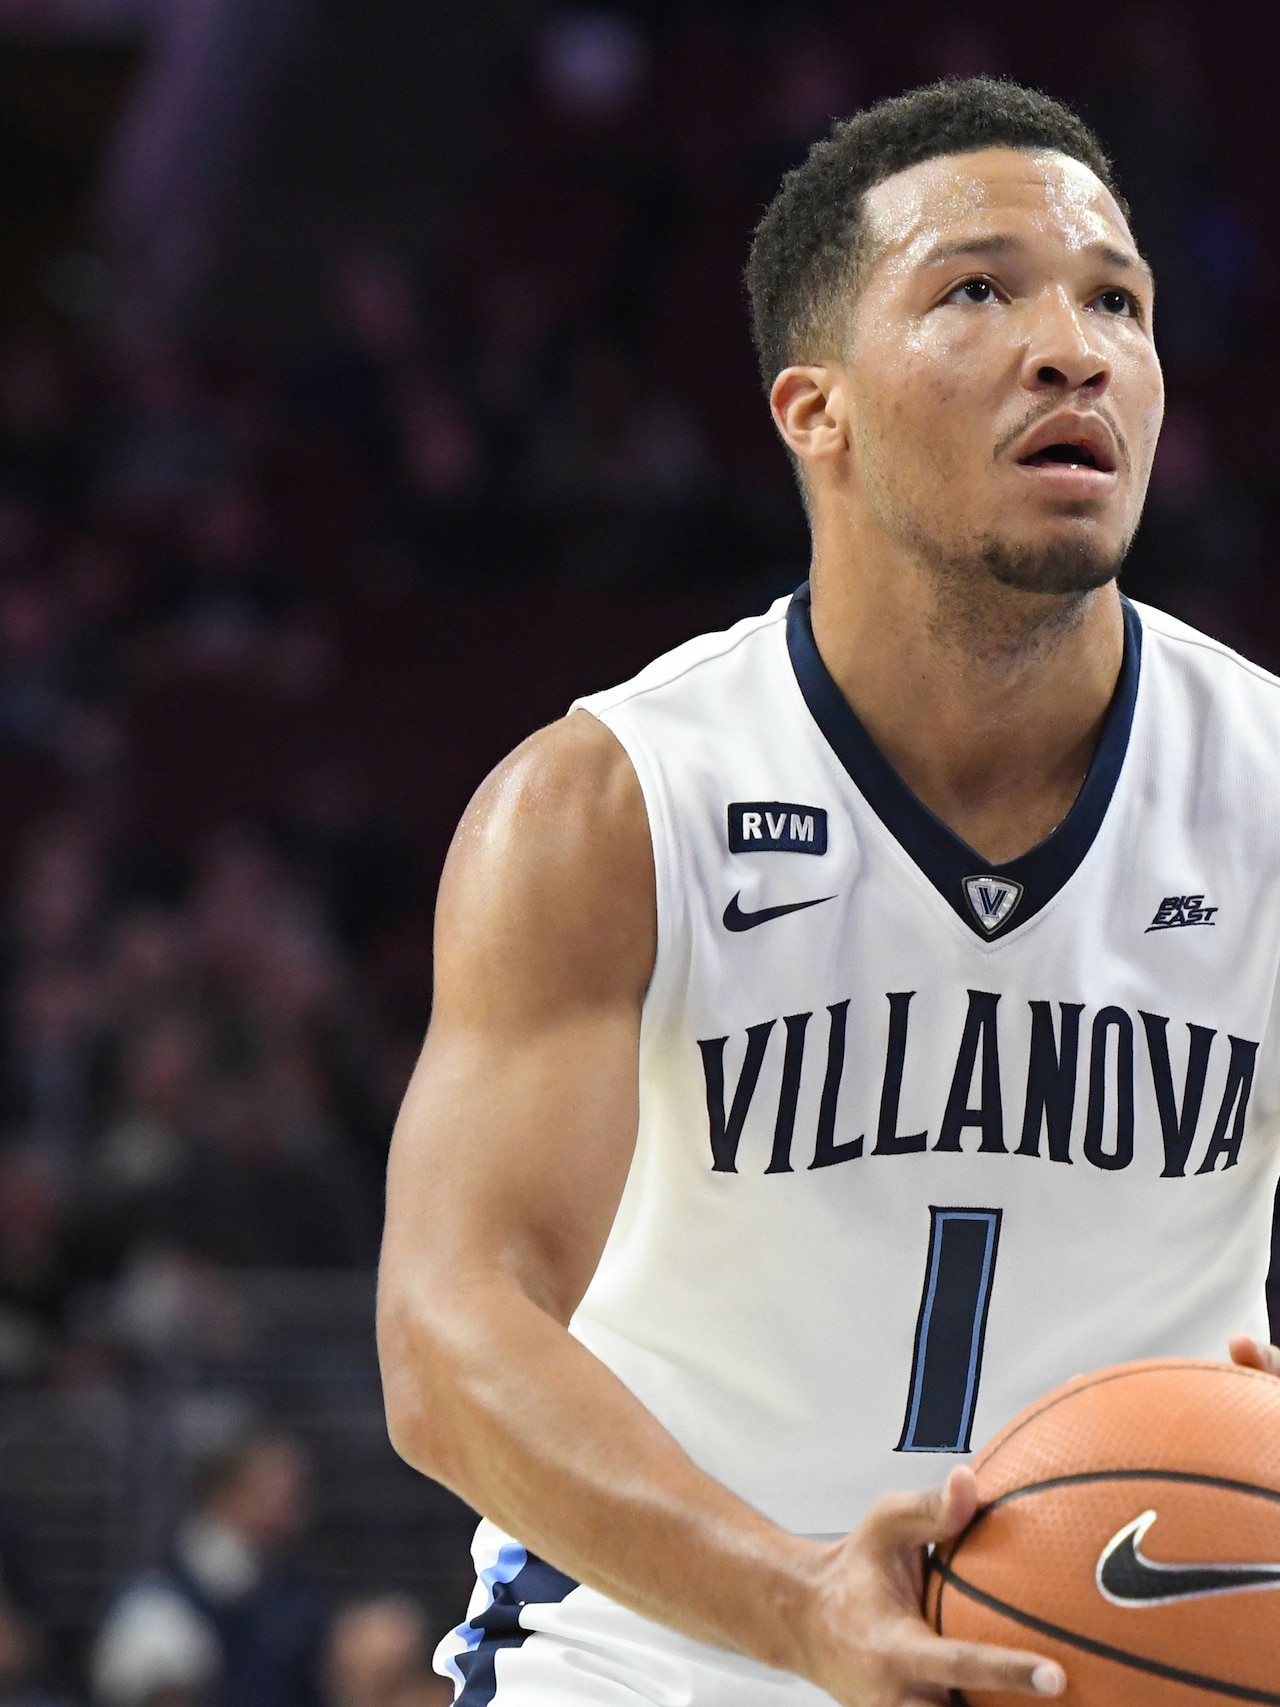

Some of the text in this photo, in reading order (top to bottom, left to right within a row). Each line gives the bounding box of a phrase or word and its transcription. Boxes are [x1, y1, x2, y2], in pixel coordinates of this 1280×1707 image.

[742, 811, 814, 842] RVM
[976, 886, 1009, 917] V
[1151, 907, 1219, 925] EAST
[1159, 895, 1205, 911] BIG
[697, 988, 1260, 1178] VILLANOVA
[893, 1205, 1003, 1453] 1
